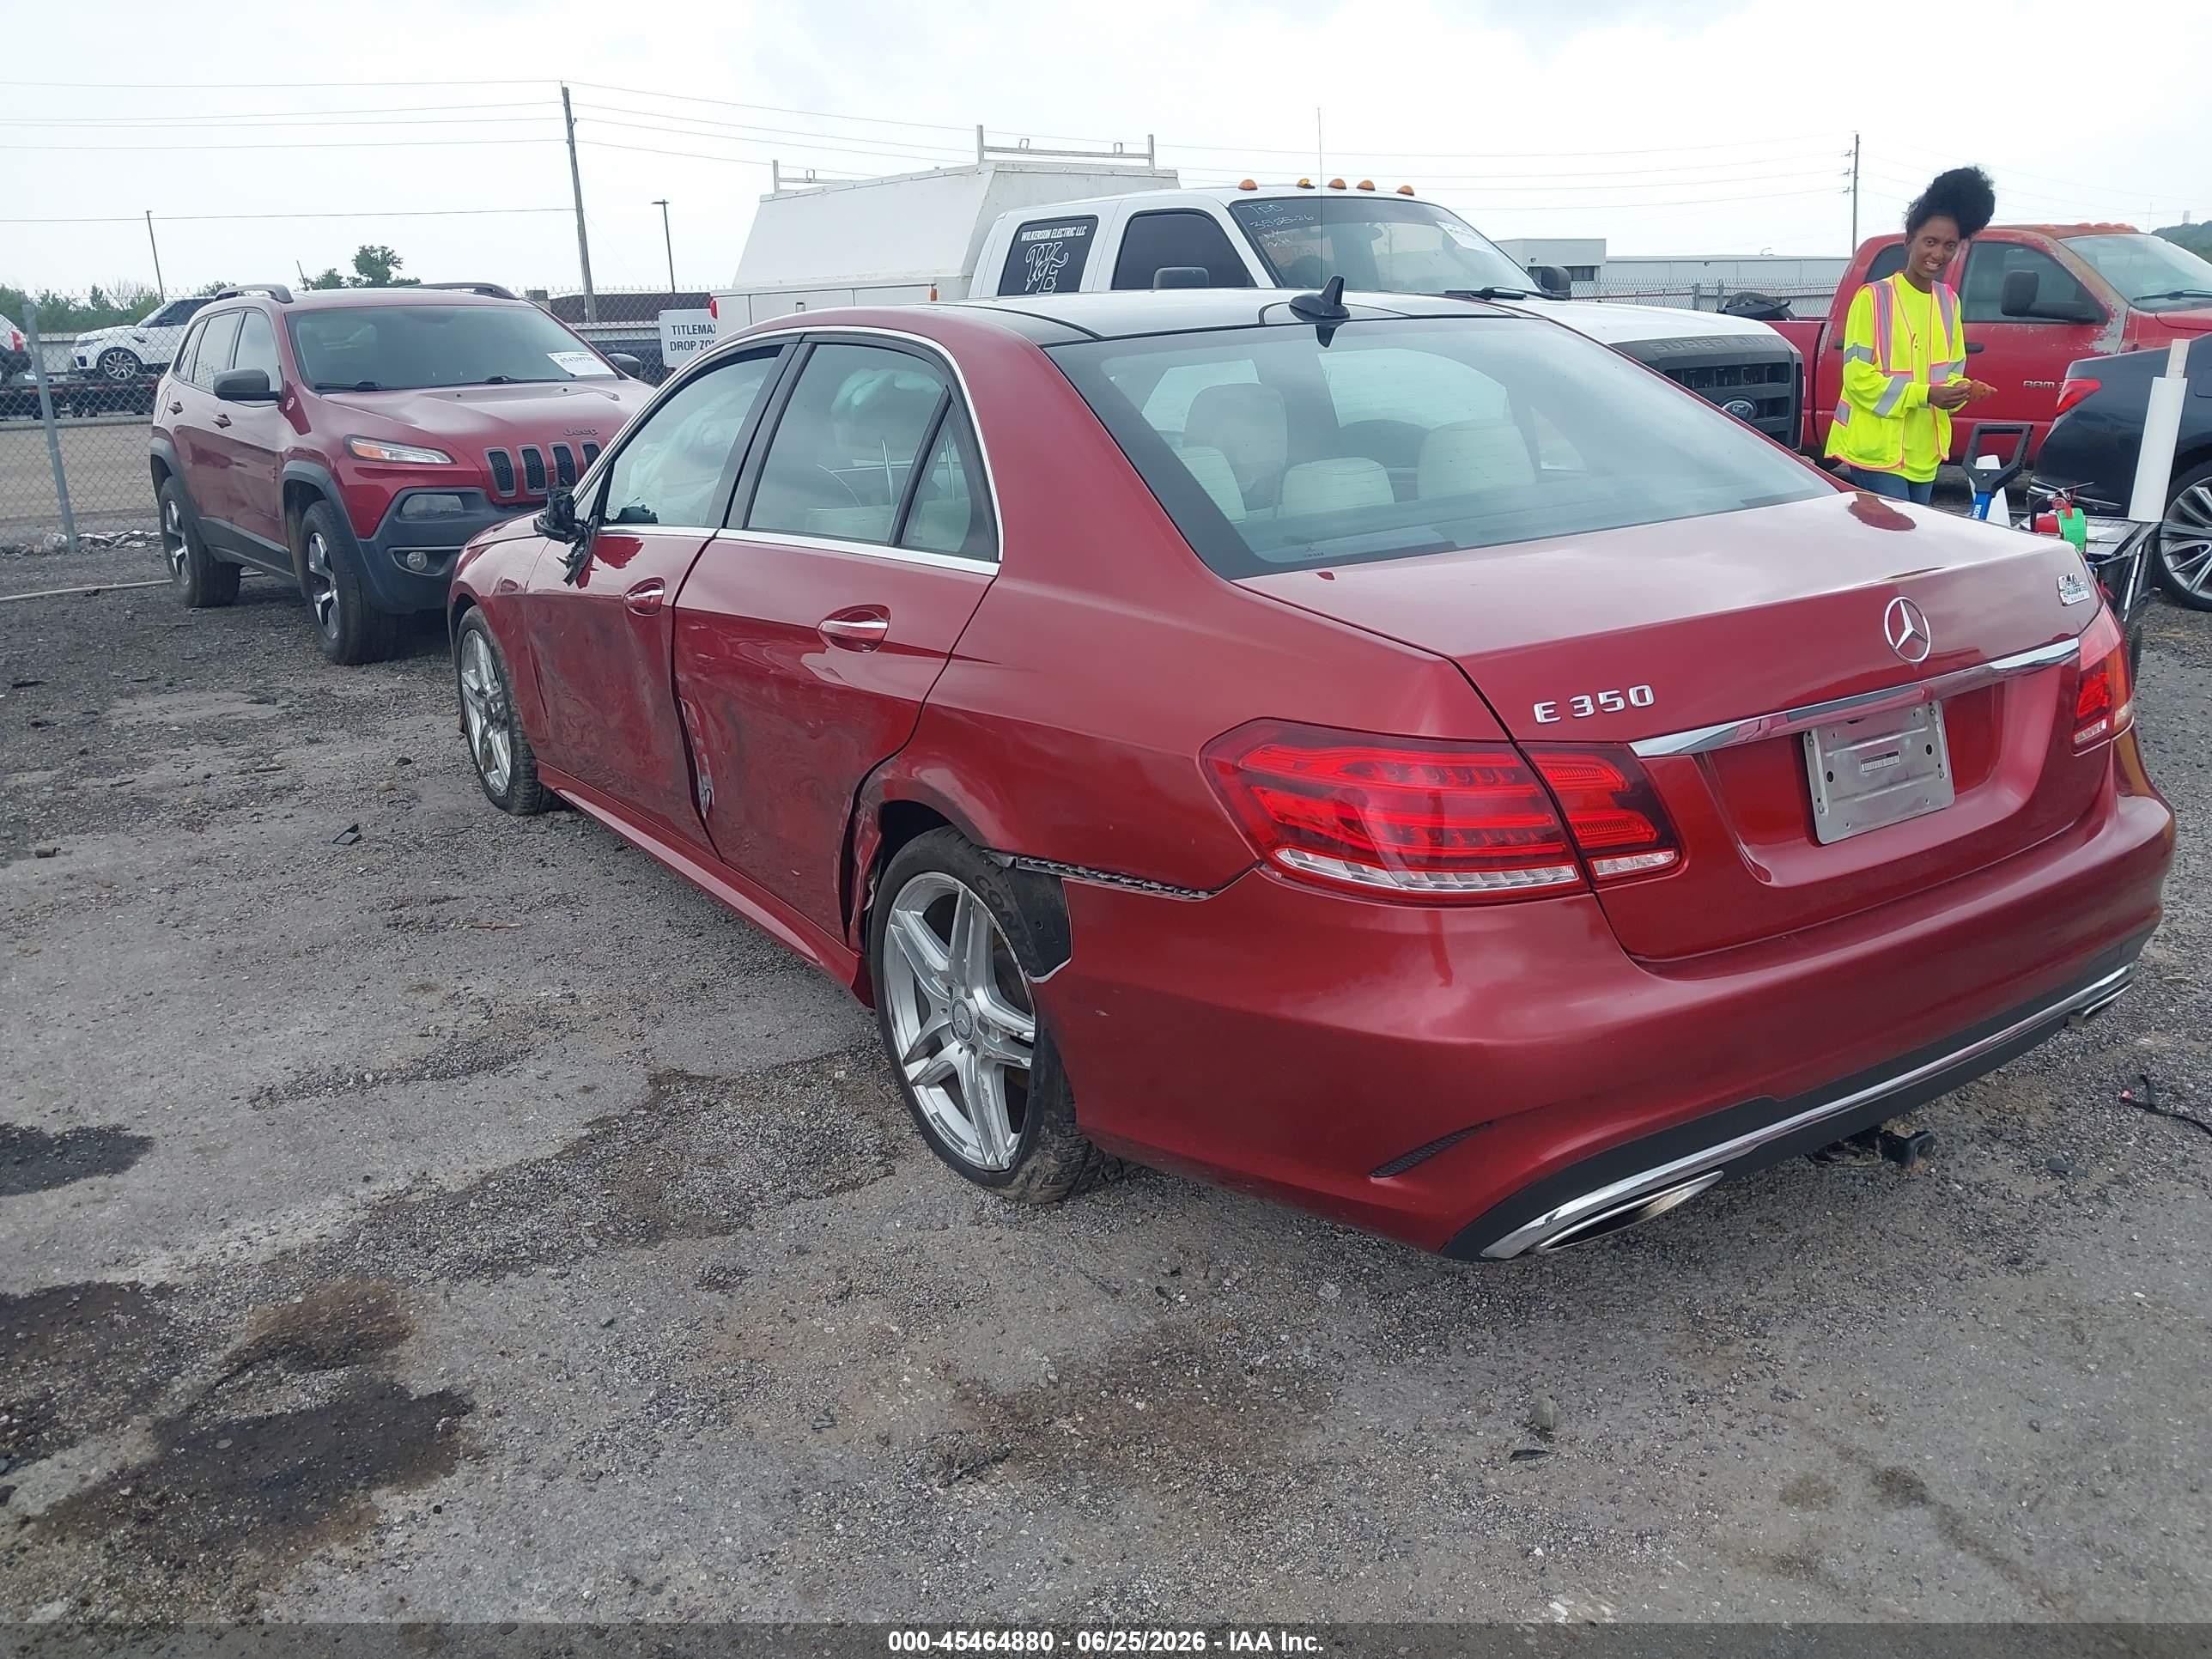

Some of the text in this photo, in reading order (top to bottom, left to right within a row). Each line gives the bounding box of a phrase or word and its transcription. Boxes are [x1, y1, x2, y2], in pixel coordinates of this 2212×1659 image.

[1021, 225, 1088, 241] WILKERSON ELECTRIC LLC
[670, 341, 696, 351] DROP
[1650, 337, 1729, 352] SUPER
[2022, 380, 2056, 390] RAM
[562, 428, 599, 436] Jeep
[1533, 684, 1655, 724] E 350
